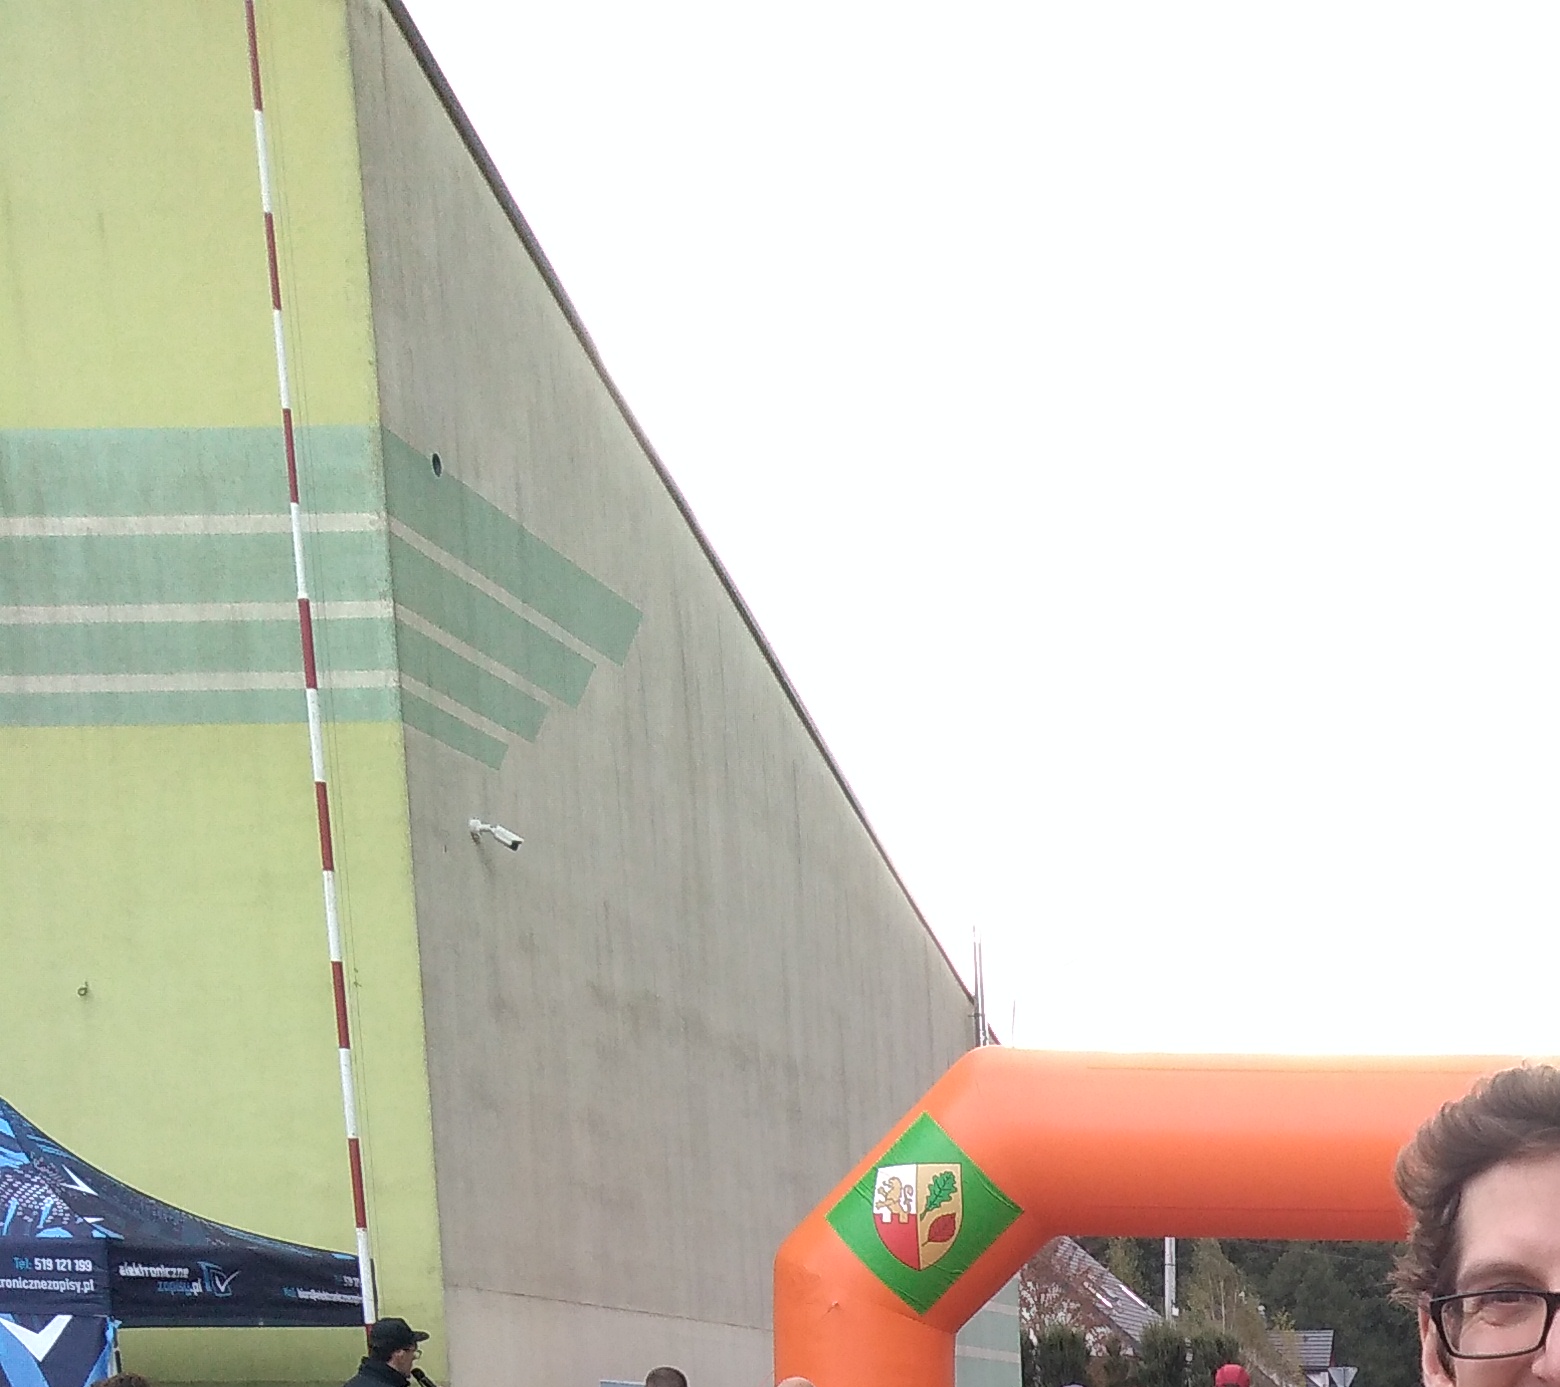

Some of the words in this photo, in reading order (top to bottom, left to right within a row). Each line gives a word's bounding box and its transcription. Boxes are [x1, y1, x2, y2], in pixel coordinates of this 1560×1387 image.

[34, 1257, 54, 1271] 519
[55, 1258, 72, 1272] 121
[73, 1259, 93, 1272] 199
[0, 1276, 95, 1294] ronicznezapisy.pl
